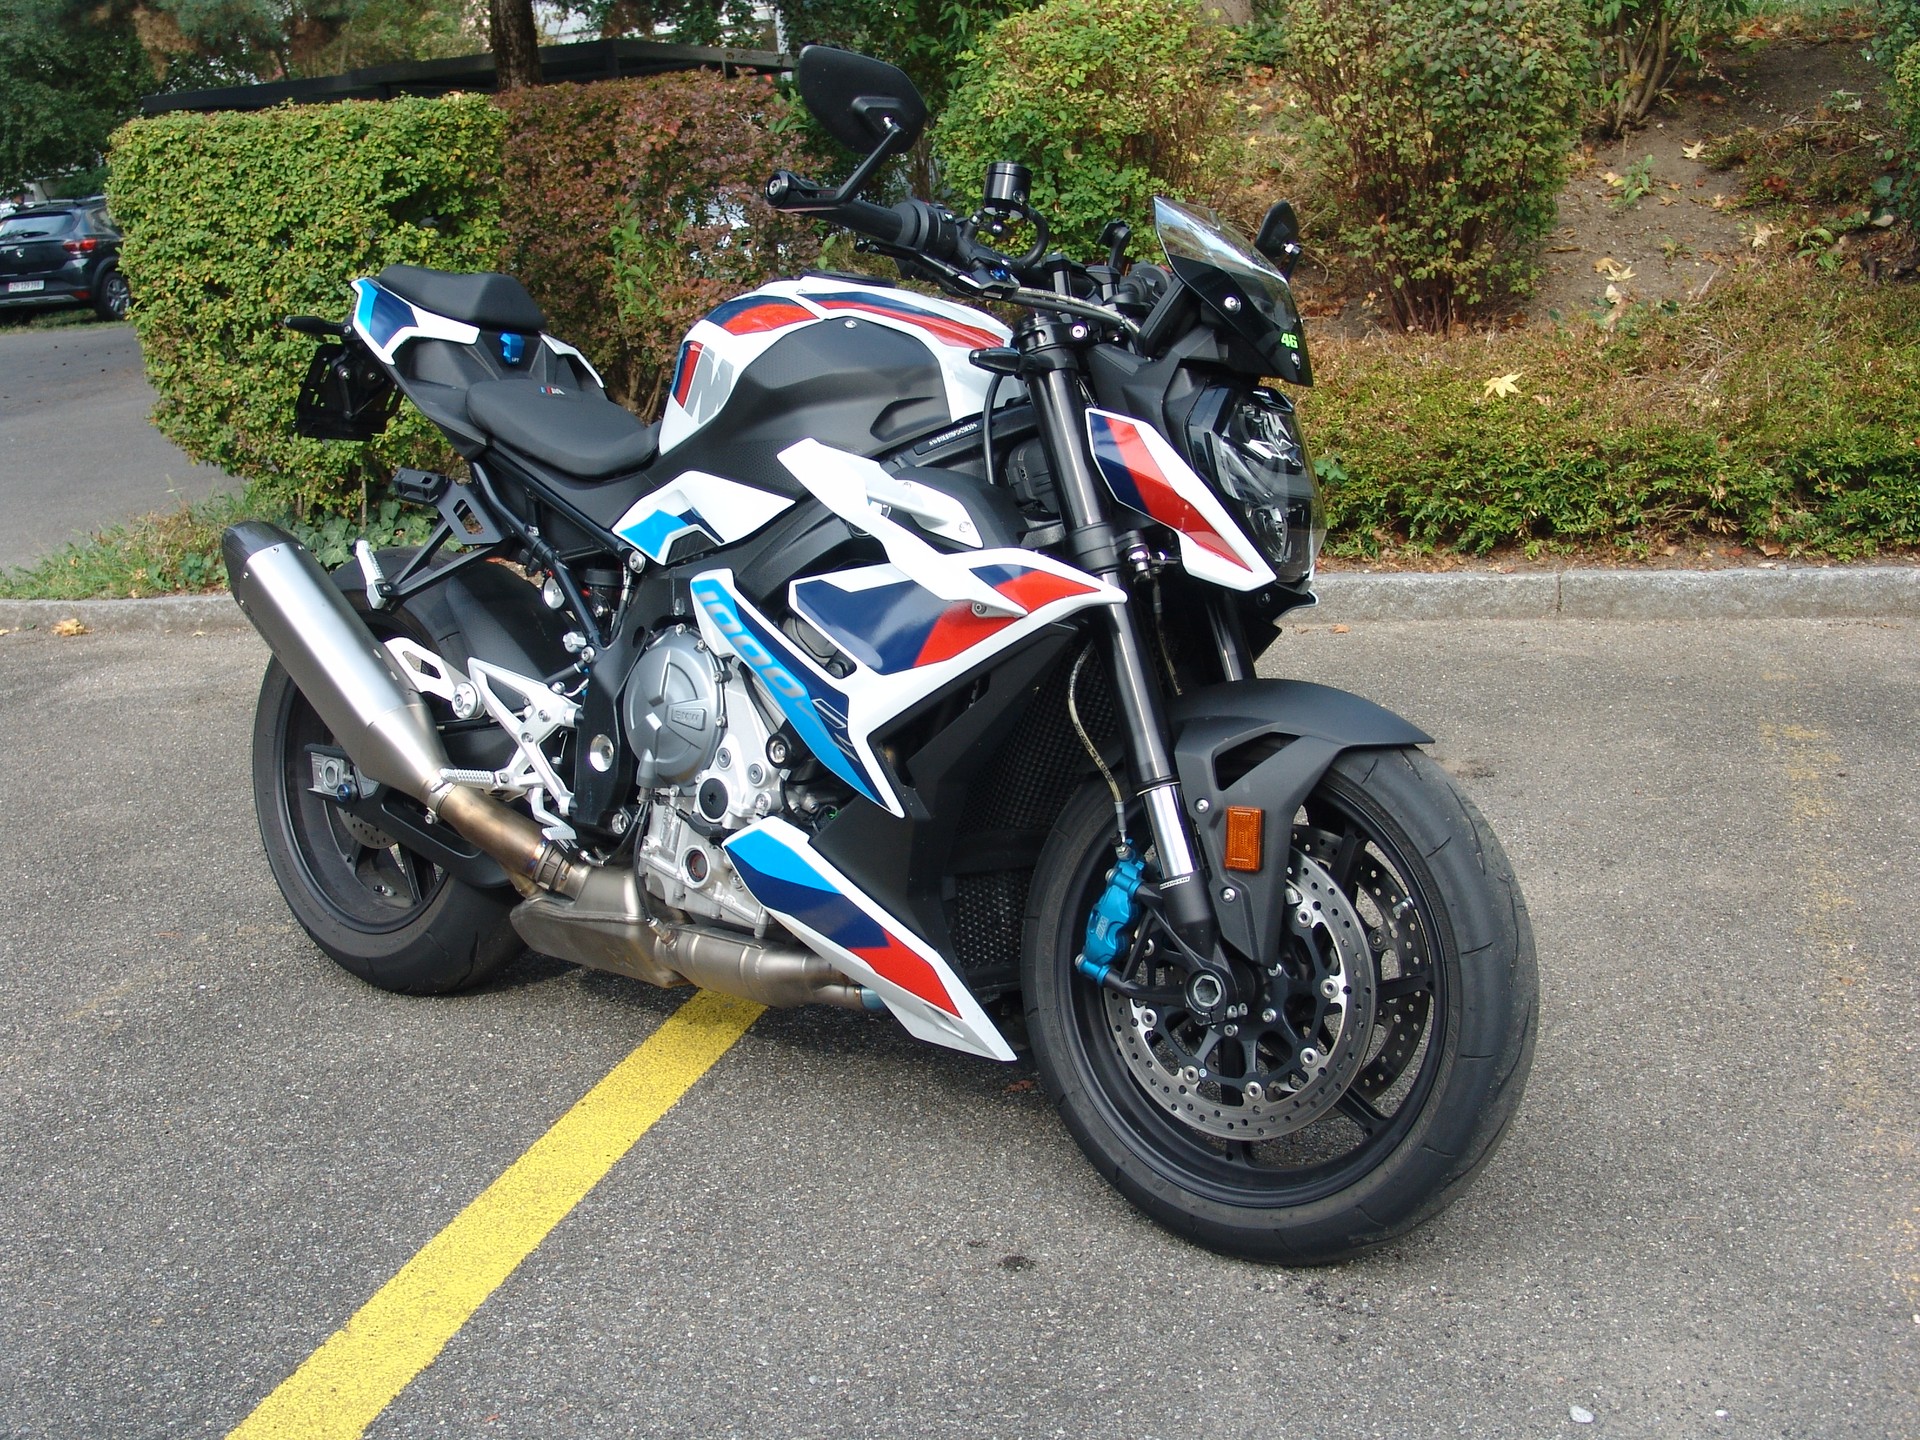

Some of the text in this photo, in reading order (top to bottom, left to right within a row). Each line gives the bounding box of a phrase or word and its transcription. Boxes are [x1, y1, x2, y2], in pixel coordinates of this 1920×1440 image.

[1281, 333, 1298, 349] 46
[697, 590, 808, 700] 1000
[674, 710, 700, 724] BMW
